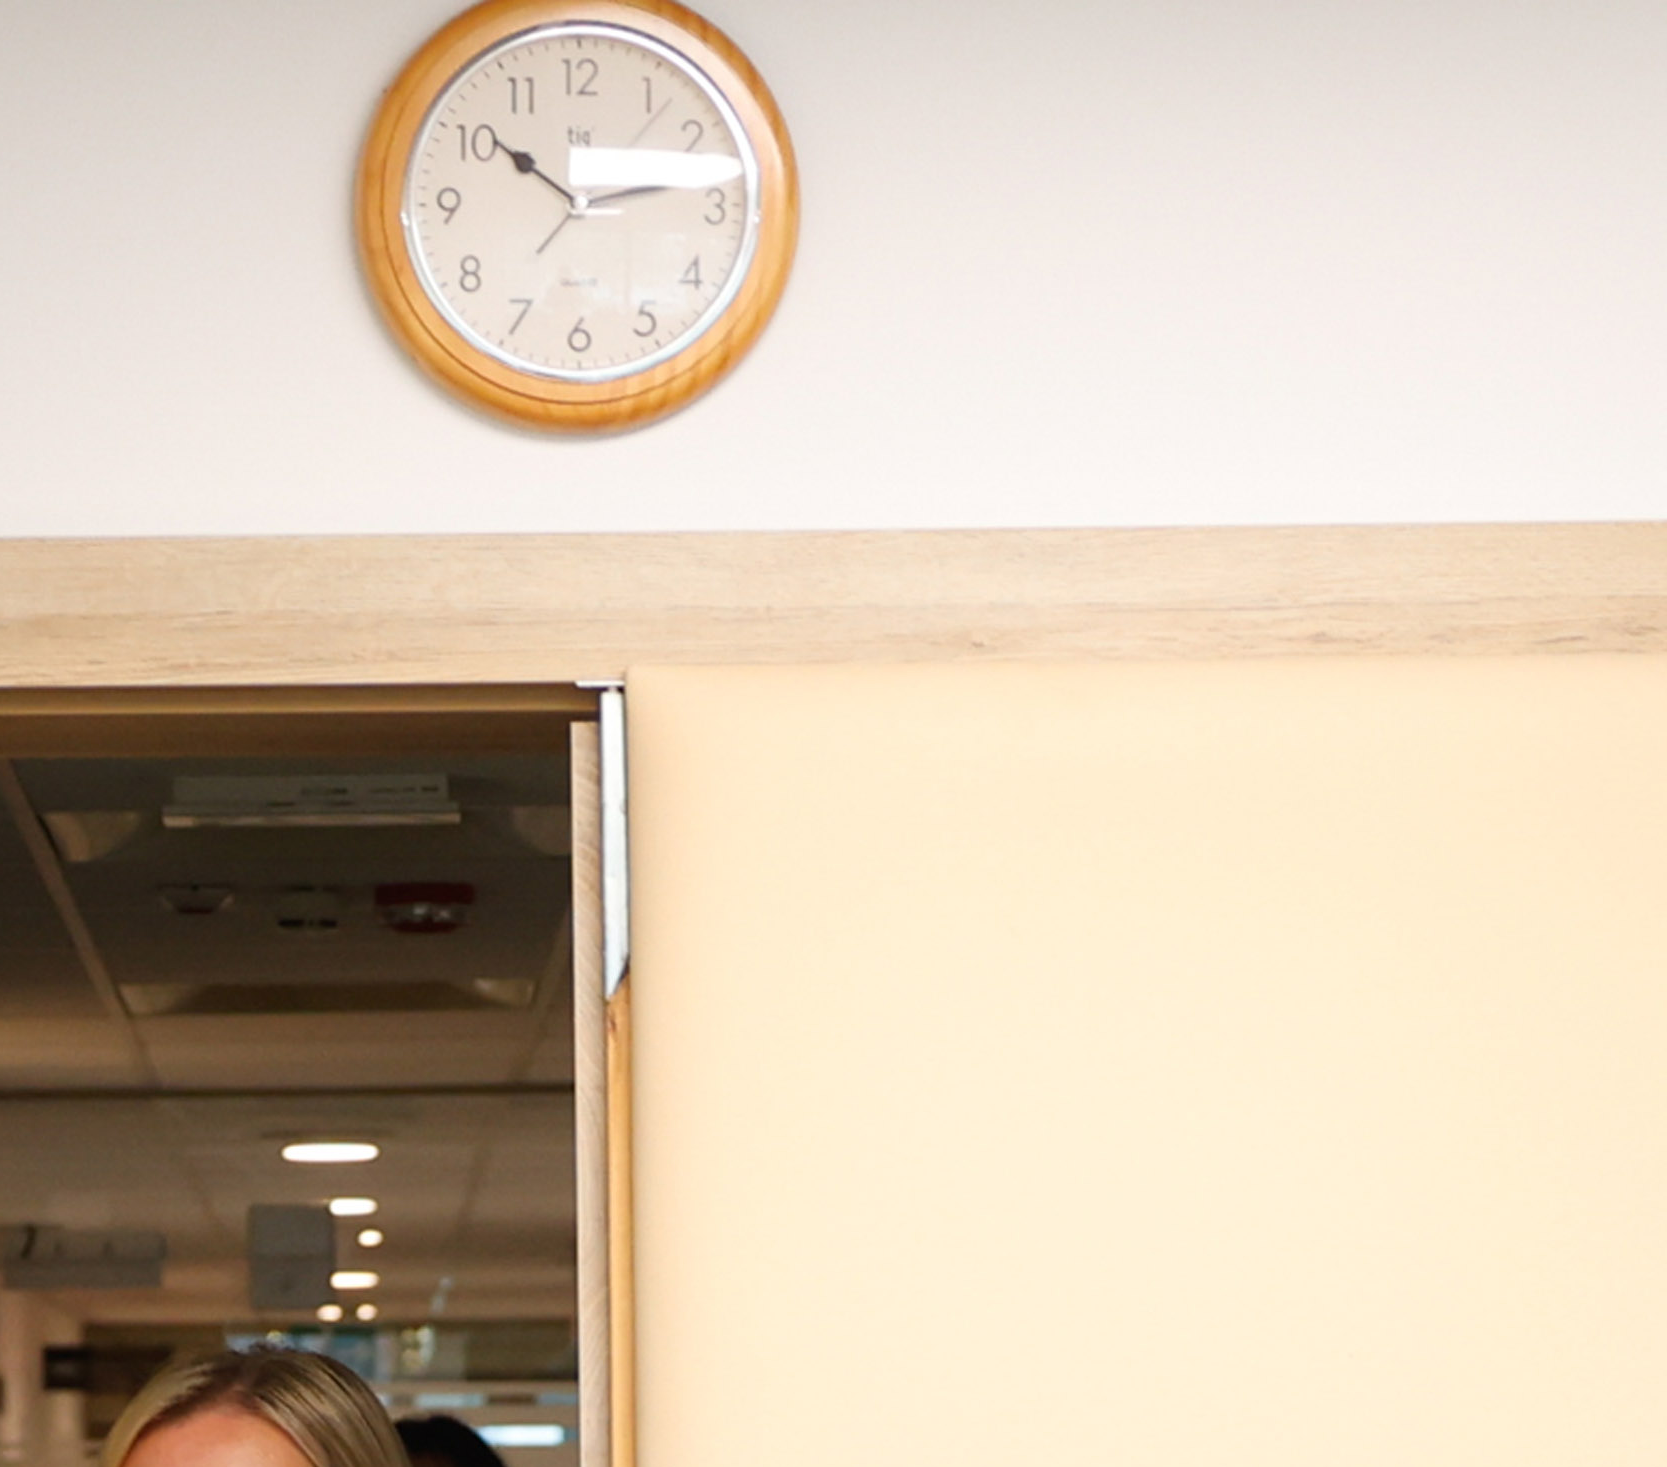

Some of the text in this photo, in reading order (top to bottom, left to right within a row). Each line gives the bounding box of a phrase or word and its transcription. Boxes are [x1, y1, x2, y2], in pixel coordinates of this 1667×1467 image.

[508, 76, 536, 114] 11
[561, 58, 599, 97] 12
[641, 76, 652, 114] 1
[456, 124, 496, 162] 10
[680, 119, 705, 154] 2
[437, 187, 462, 225] 9
[703, 187, 727, 226] 3
[459, 254, 482, 293] 8
[678, 253, 703, 291] 4
[508, 299, 534, 336] 7
[567, 316, 592, 353] 6
[633, 301, 658, 338] 5
